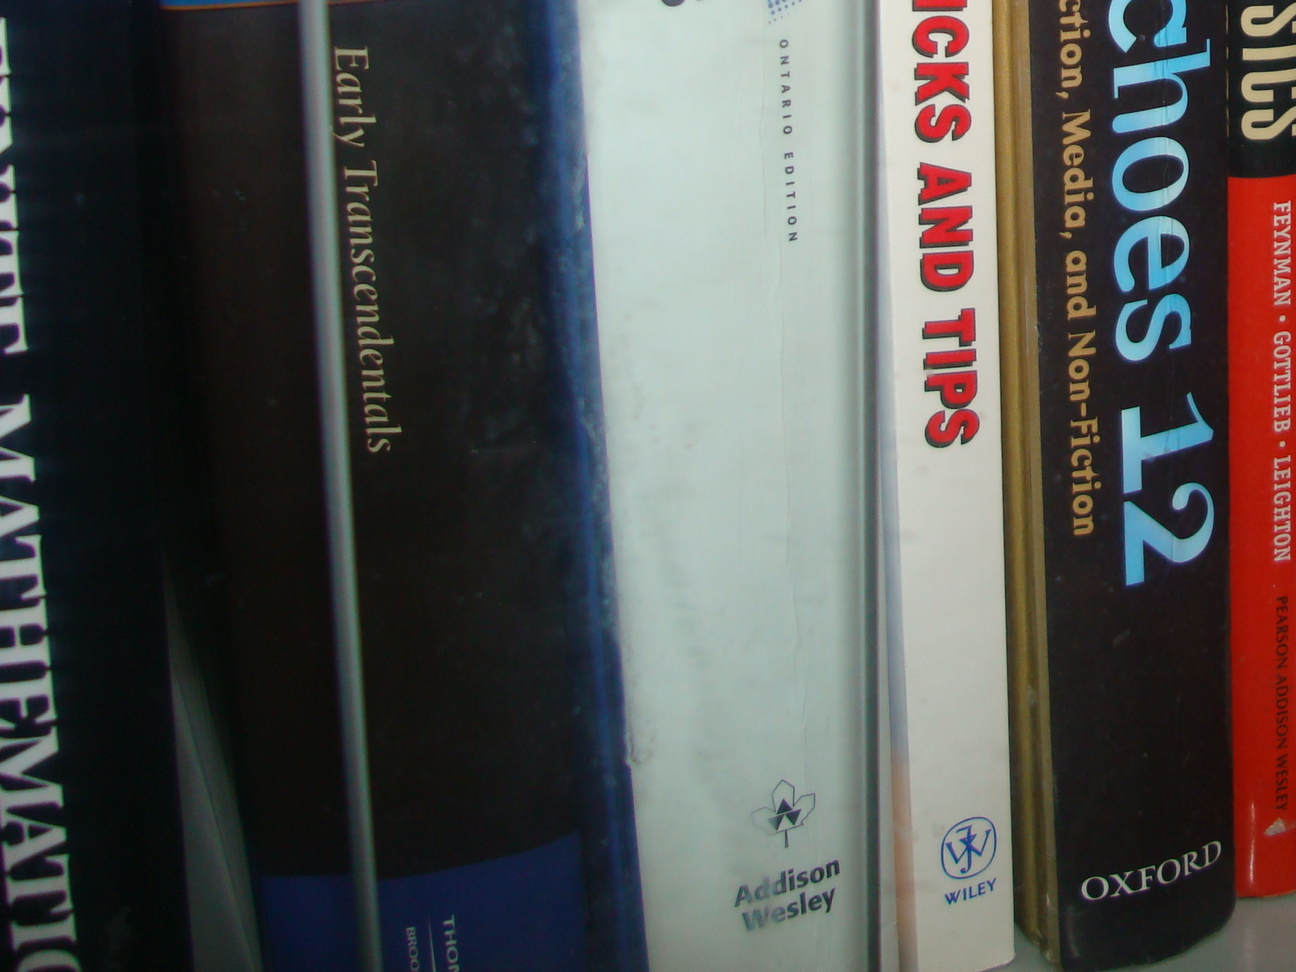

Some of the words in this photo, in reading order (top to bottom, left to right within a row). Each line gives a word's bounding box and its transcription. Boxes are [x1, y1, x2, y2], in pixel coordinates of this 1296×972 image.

[331, 45, 378, 148] Early
[779, 39, 793, 135] ONTARIO
[784, 151, 798, 242] EDITION
[1060, 108, 1094, 241] Media,
[916, 162, 976, 293] AND
[1273, 200, 1291, 306] FEYNMAN
[343, 159, 402, 454] Transcendentals
[1065, 250, 1096, 319] and
[921, 308, 980, 449] TIPS
[1273, 331, 1291, 434] GOTTLIEB
[1067, 330, 1102, 537] Non-Fiction
[1121, 391, 1215, 587] 12
[1272, 455, 1291, 562] LEIGHTON
[1275, 596, 1289, 669] PEARSON
[1275, 673, 1289, 749] ADDISON
[1275, 754, 1289, 811] WESLEY
[734, 859, 840, 907] Addison
[742, 888, 836, 932] Wesley
[944, 877, 997, 906] WILEY
[1080, 840, 1222, 901] OXFORD
